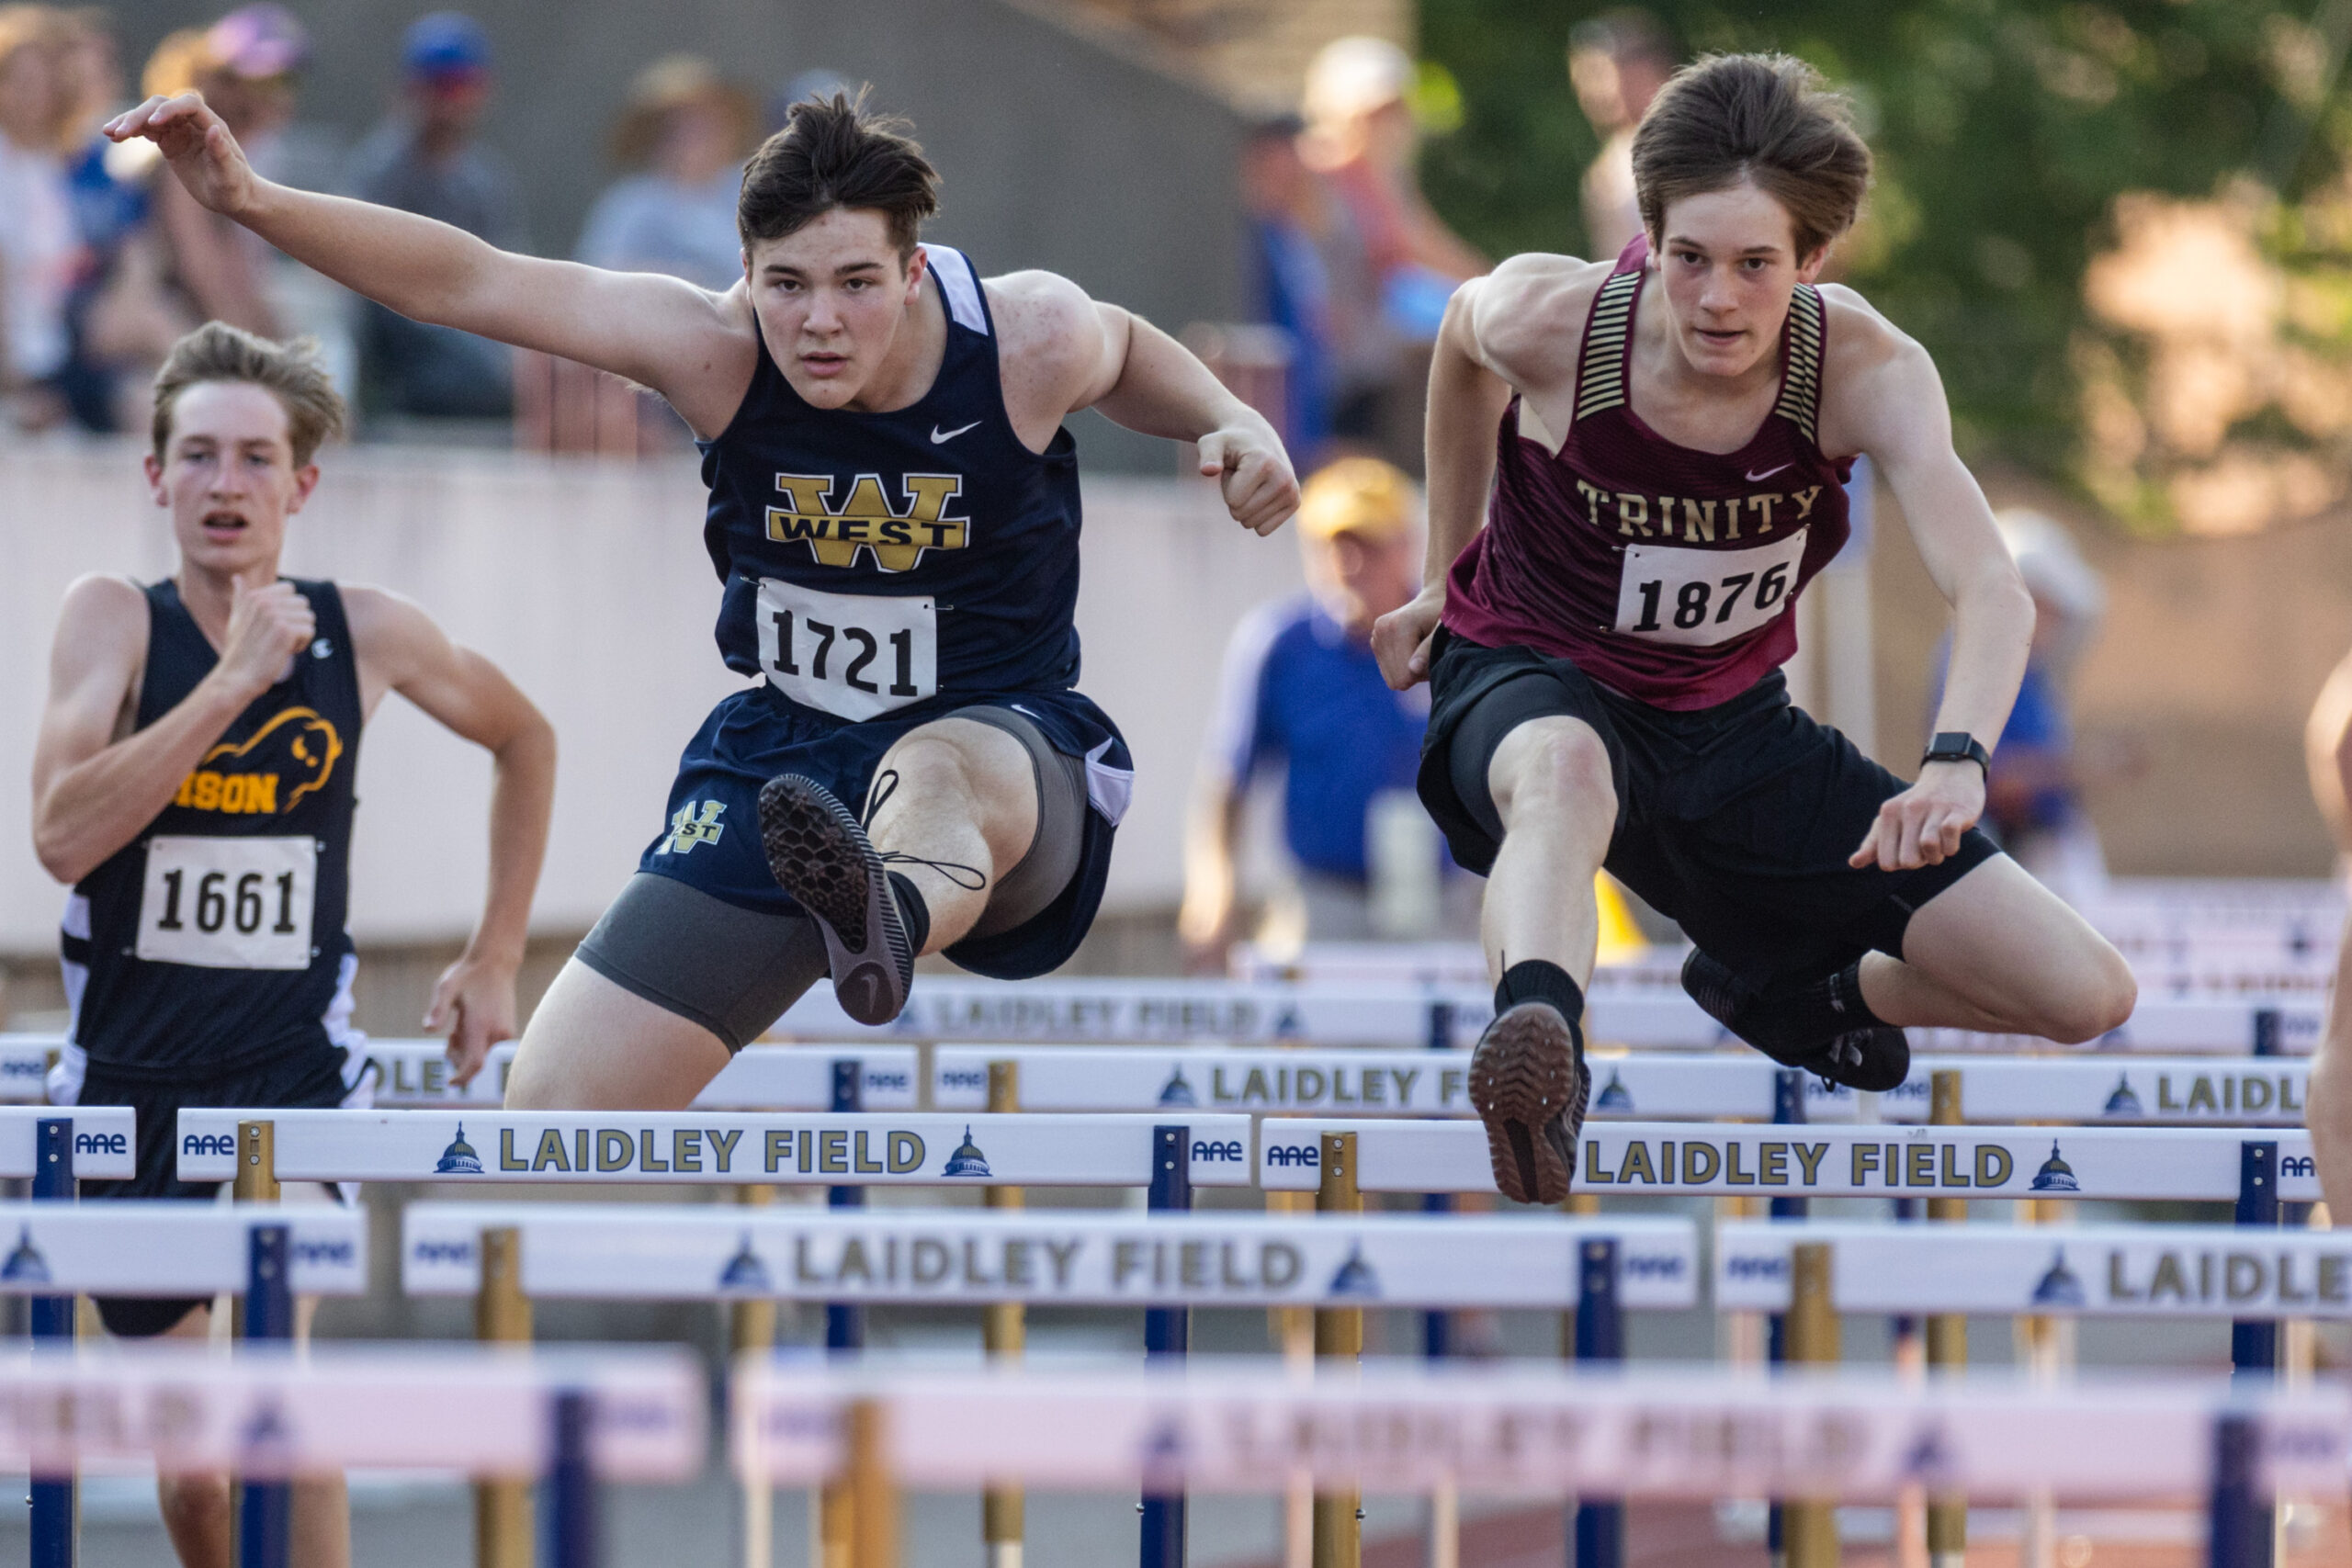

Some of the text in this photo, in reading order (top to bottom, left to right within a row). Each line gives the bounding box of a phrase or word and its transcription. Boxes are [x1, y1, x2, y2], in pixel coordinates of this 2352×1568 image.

[778, 514, 957, 548] WEST
[1577, 479, 1824, 543] TRINITY
[1632, 561, 1791, 633] 1876
[773, 609, 918, 698] 1721
[172, 771, 279, 814] ISON
[156, 869, 297, 934] 1661
[1213, 1067, 1419, 1102] LAIDLEY
[2157, 1077, 2310, 1111] LAIDL
[499, 1128, 926, 1174] LAIDLEY FIELD
[1584, 1140, 2015, 1189] LAIDLEY FIELD
[2280, 1156, 2316, 1177] AA
[794, 1236, 1306, 1288] LAIDLEY FIELD
